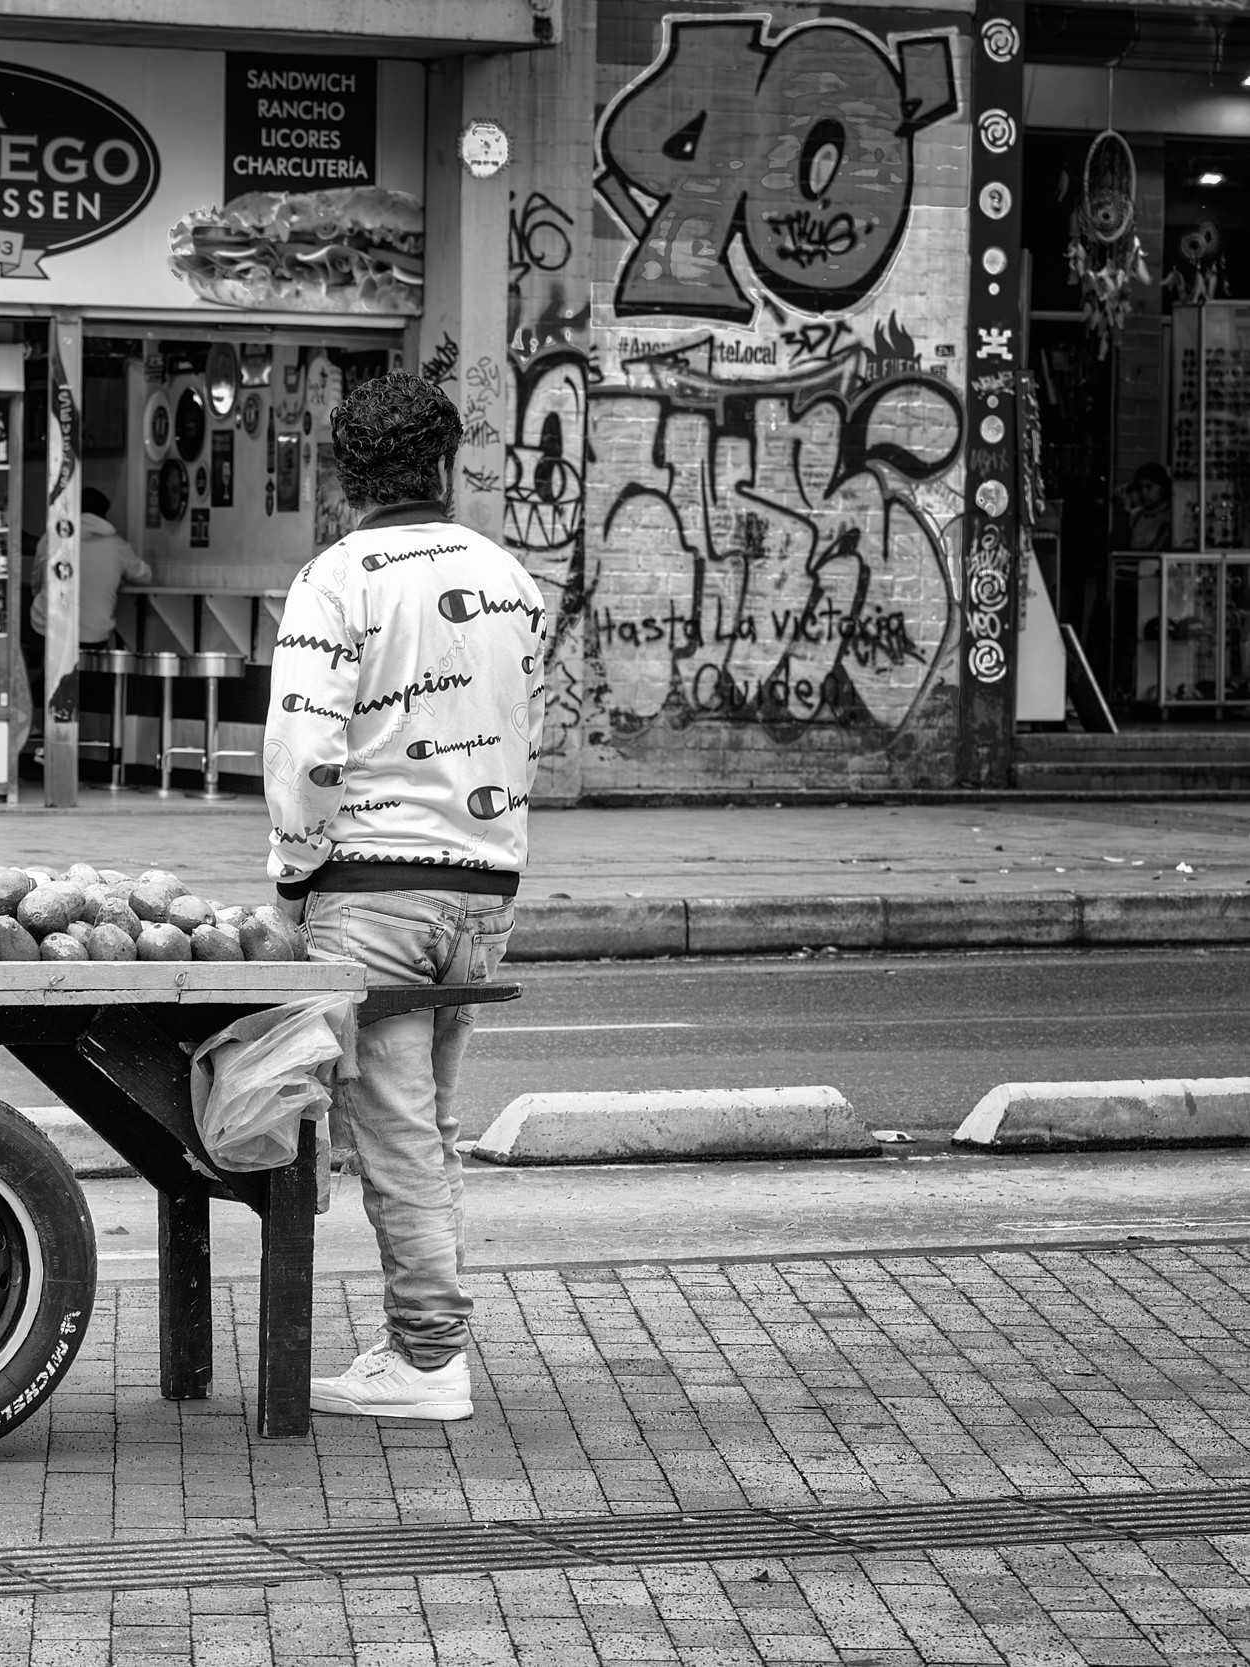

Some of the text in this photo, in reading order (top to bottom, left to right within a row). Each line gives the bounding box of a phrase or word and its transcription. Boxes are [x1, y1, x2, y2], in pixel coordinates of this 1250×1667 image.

[247, 69, 356, 92] SANDWICH
[258, 99, 346, 121] RANCHO
[261, 127, 342, 149] LICORES
[233, 155, 369, 180] CHARCUTERÍA
[362, 543, 468, 572] Champion
[594, 599, 704, 650] Hasta
